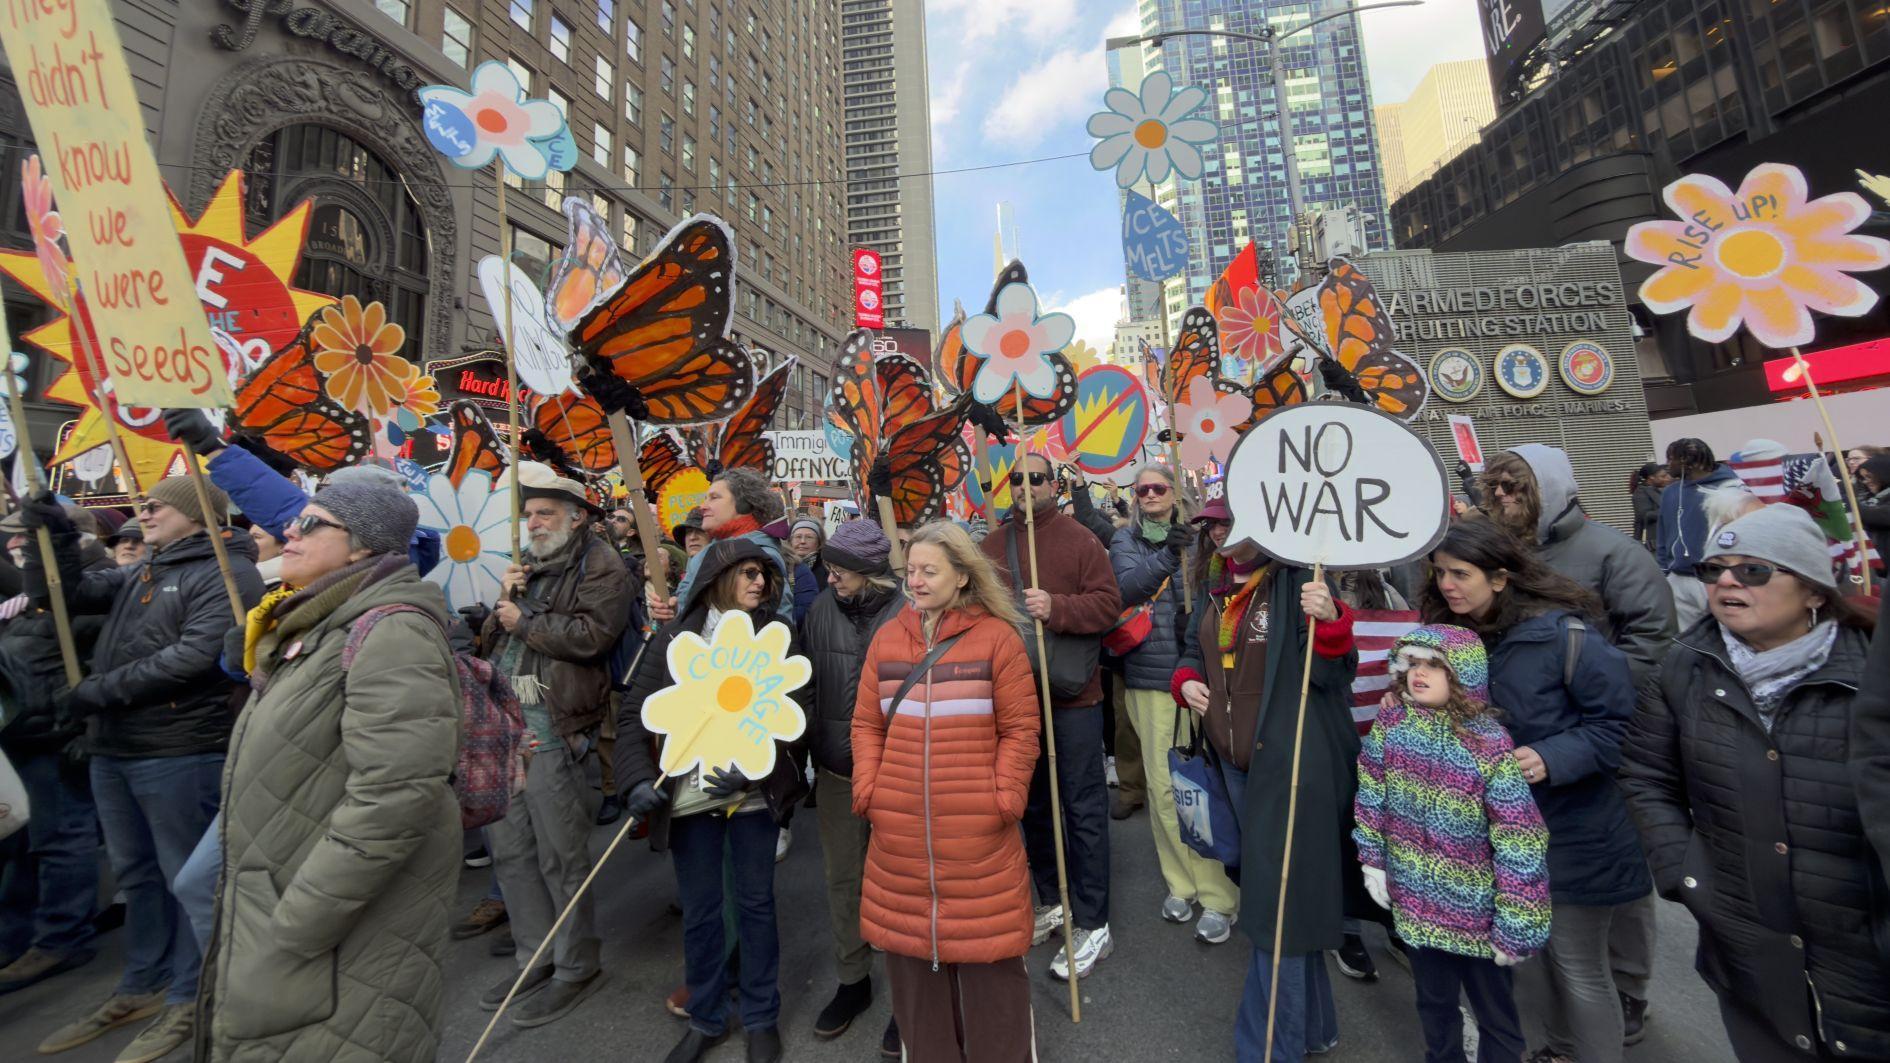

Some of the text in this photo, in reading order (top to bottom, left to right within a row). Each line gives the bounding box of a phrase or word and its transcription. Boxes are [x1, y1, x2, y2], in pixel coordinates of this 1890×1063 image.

[28, 31, 109, 110] didn't
[53, 132, 132, 192] know
[89, 207, 134, 247] we
[1124, 203, 1168, 239] ICE
[1668, 194, 1777, 270] RISE UP!
[1126, 229, 1188, 282] MELTS
[94, 269, 169, 309] were
[1388, 280, 1616, 316] ARMED FORCES
[1506, 310, 1607, 335] STATION
[110, 326, 213, 395] seeds
[460, 370, 501, 396] Hard
[1278, 421, 1353, 478] NO
[1260, 477, 1409, 543] WAR
[688, 645, 784, 746] COURAGE
